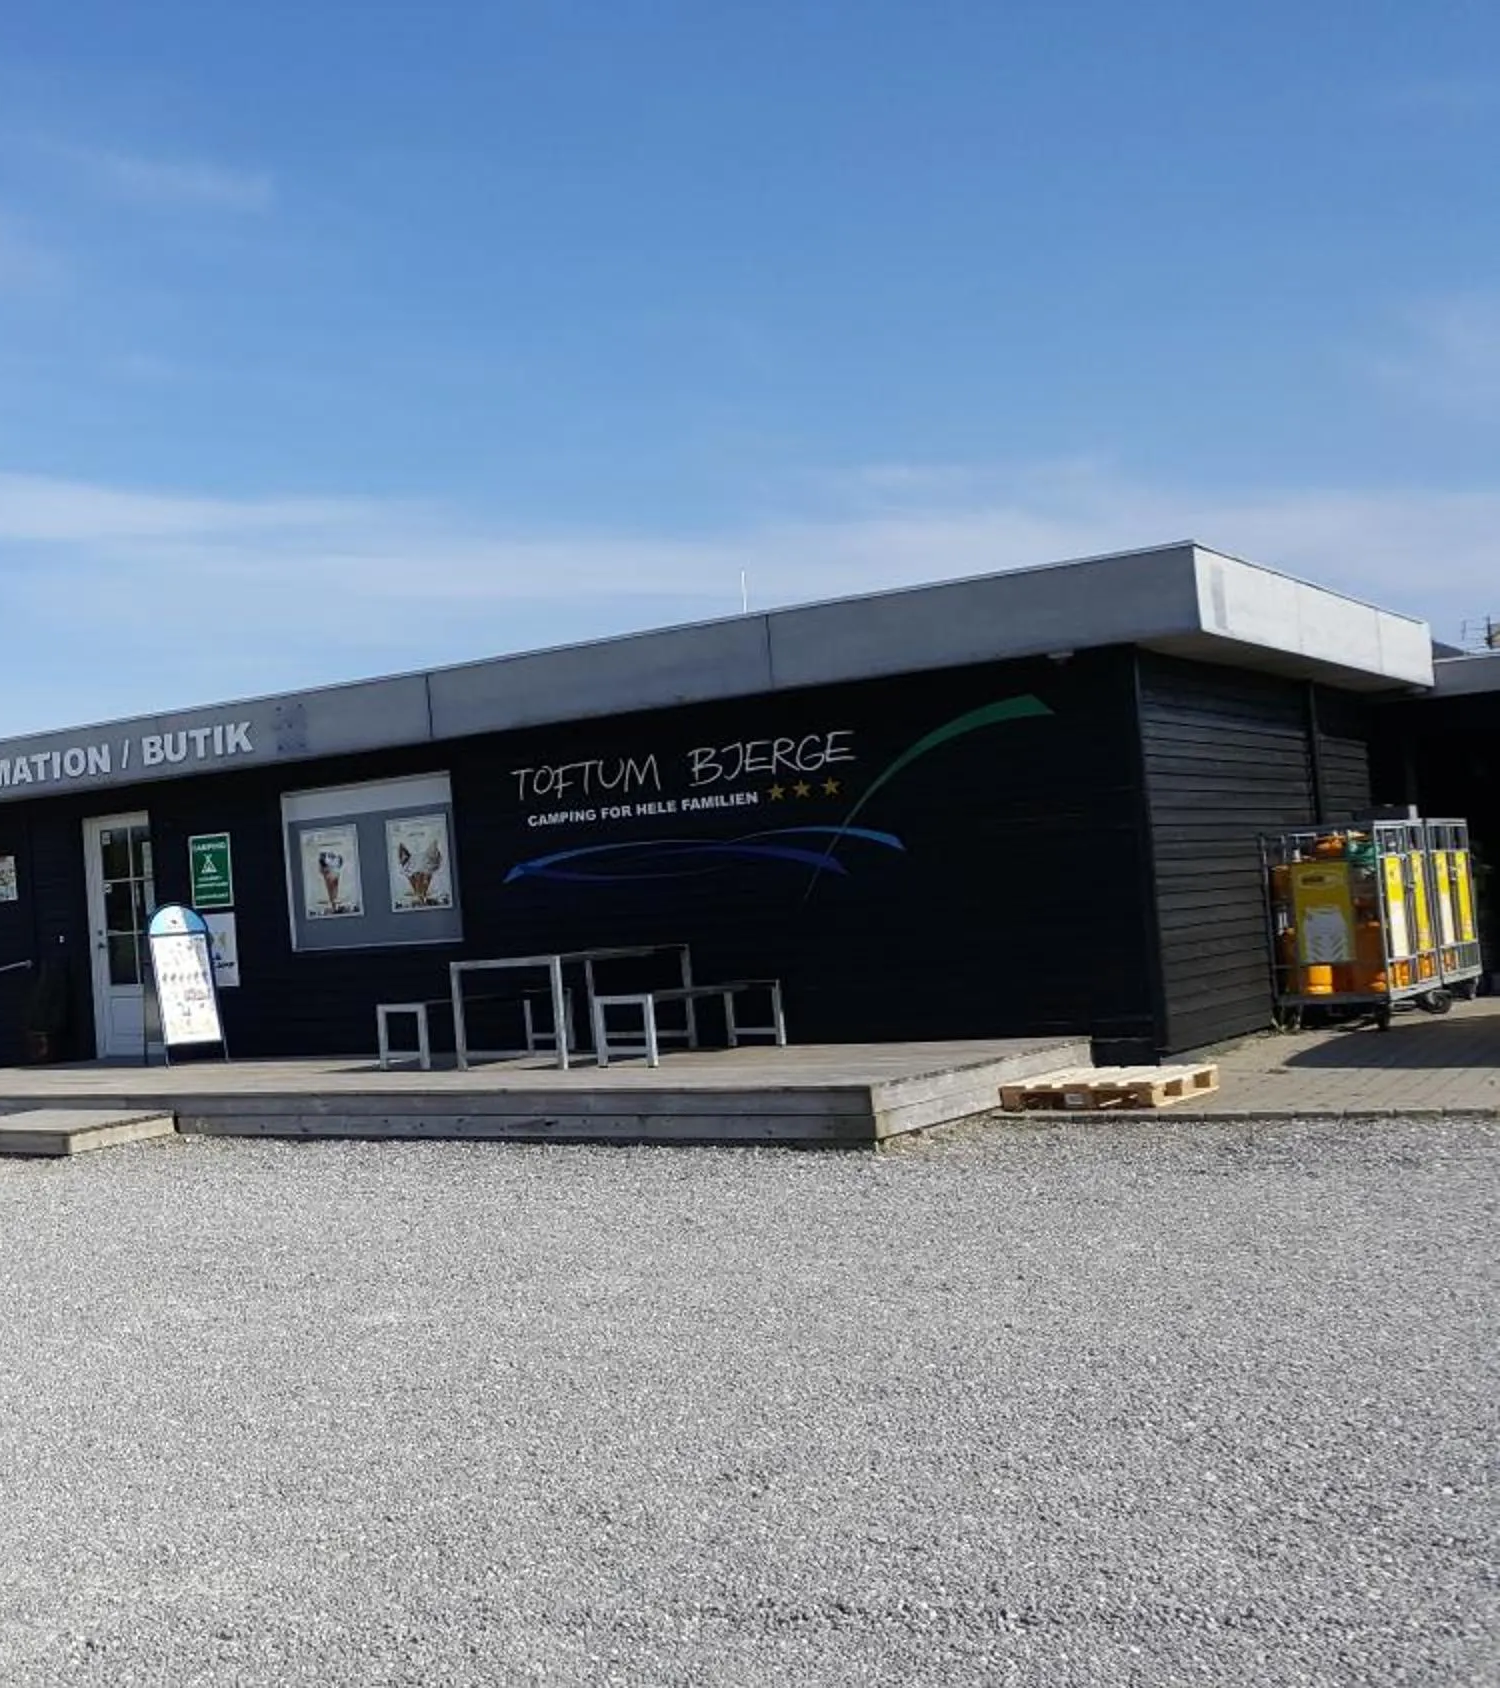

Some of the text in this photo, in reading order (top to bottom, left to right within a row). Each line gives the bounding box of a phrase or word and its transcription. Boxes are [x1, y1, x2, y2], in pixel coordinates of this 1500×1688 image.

[121, 738, 130, 769] /
[141, 721, 253, 766] BUTIK
[509, 730, 857, 801] TOFTUM BJERGE
[527, 790, 759, 827] CAMPING FOR HELE FAMILIEN
